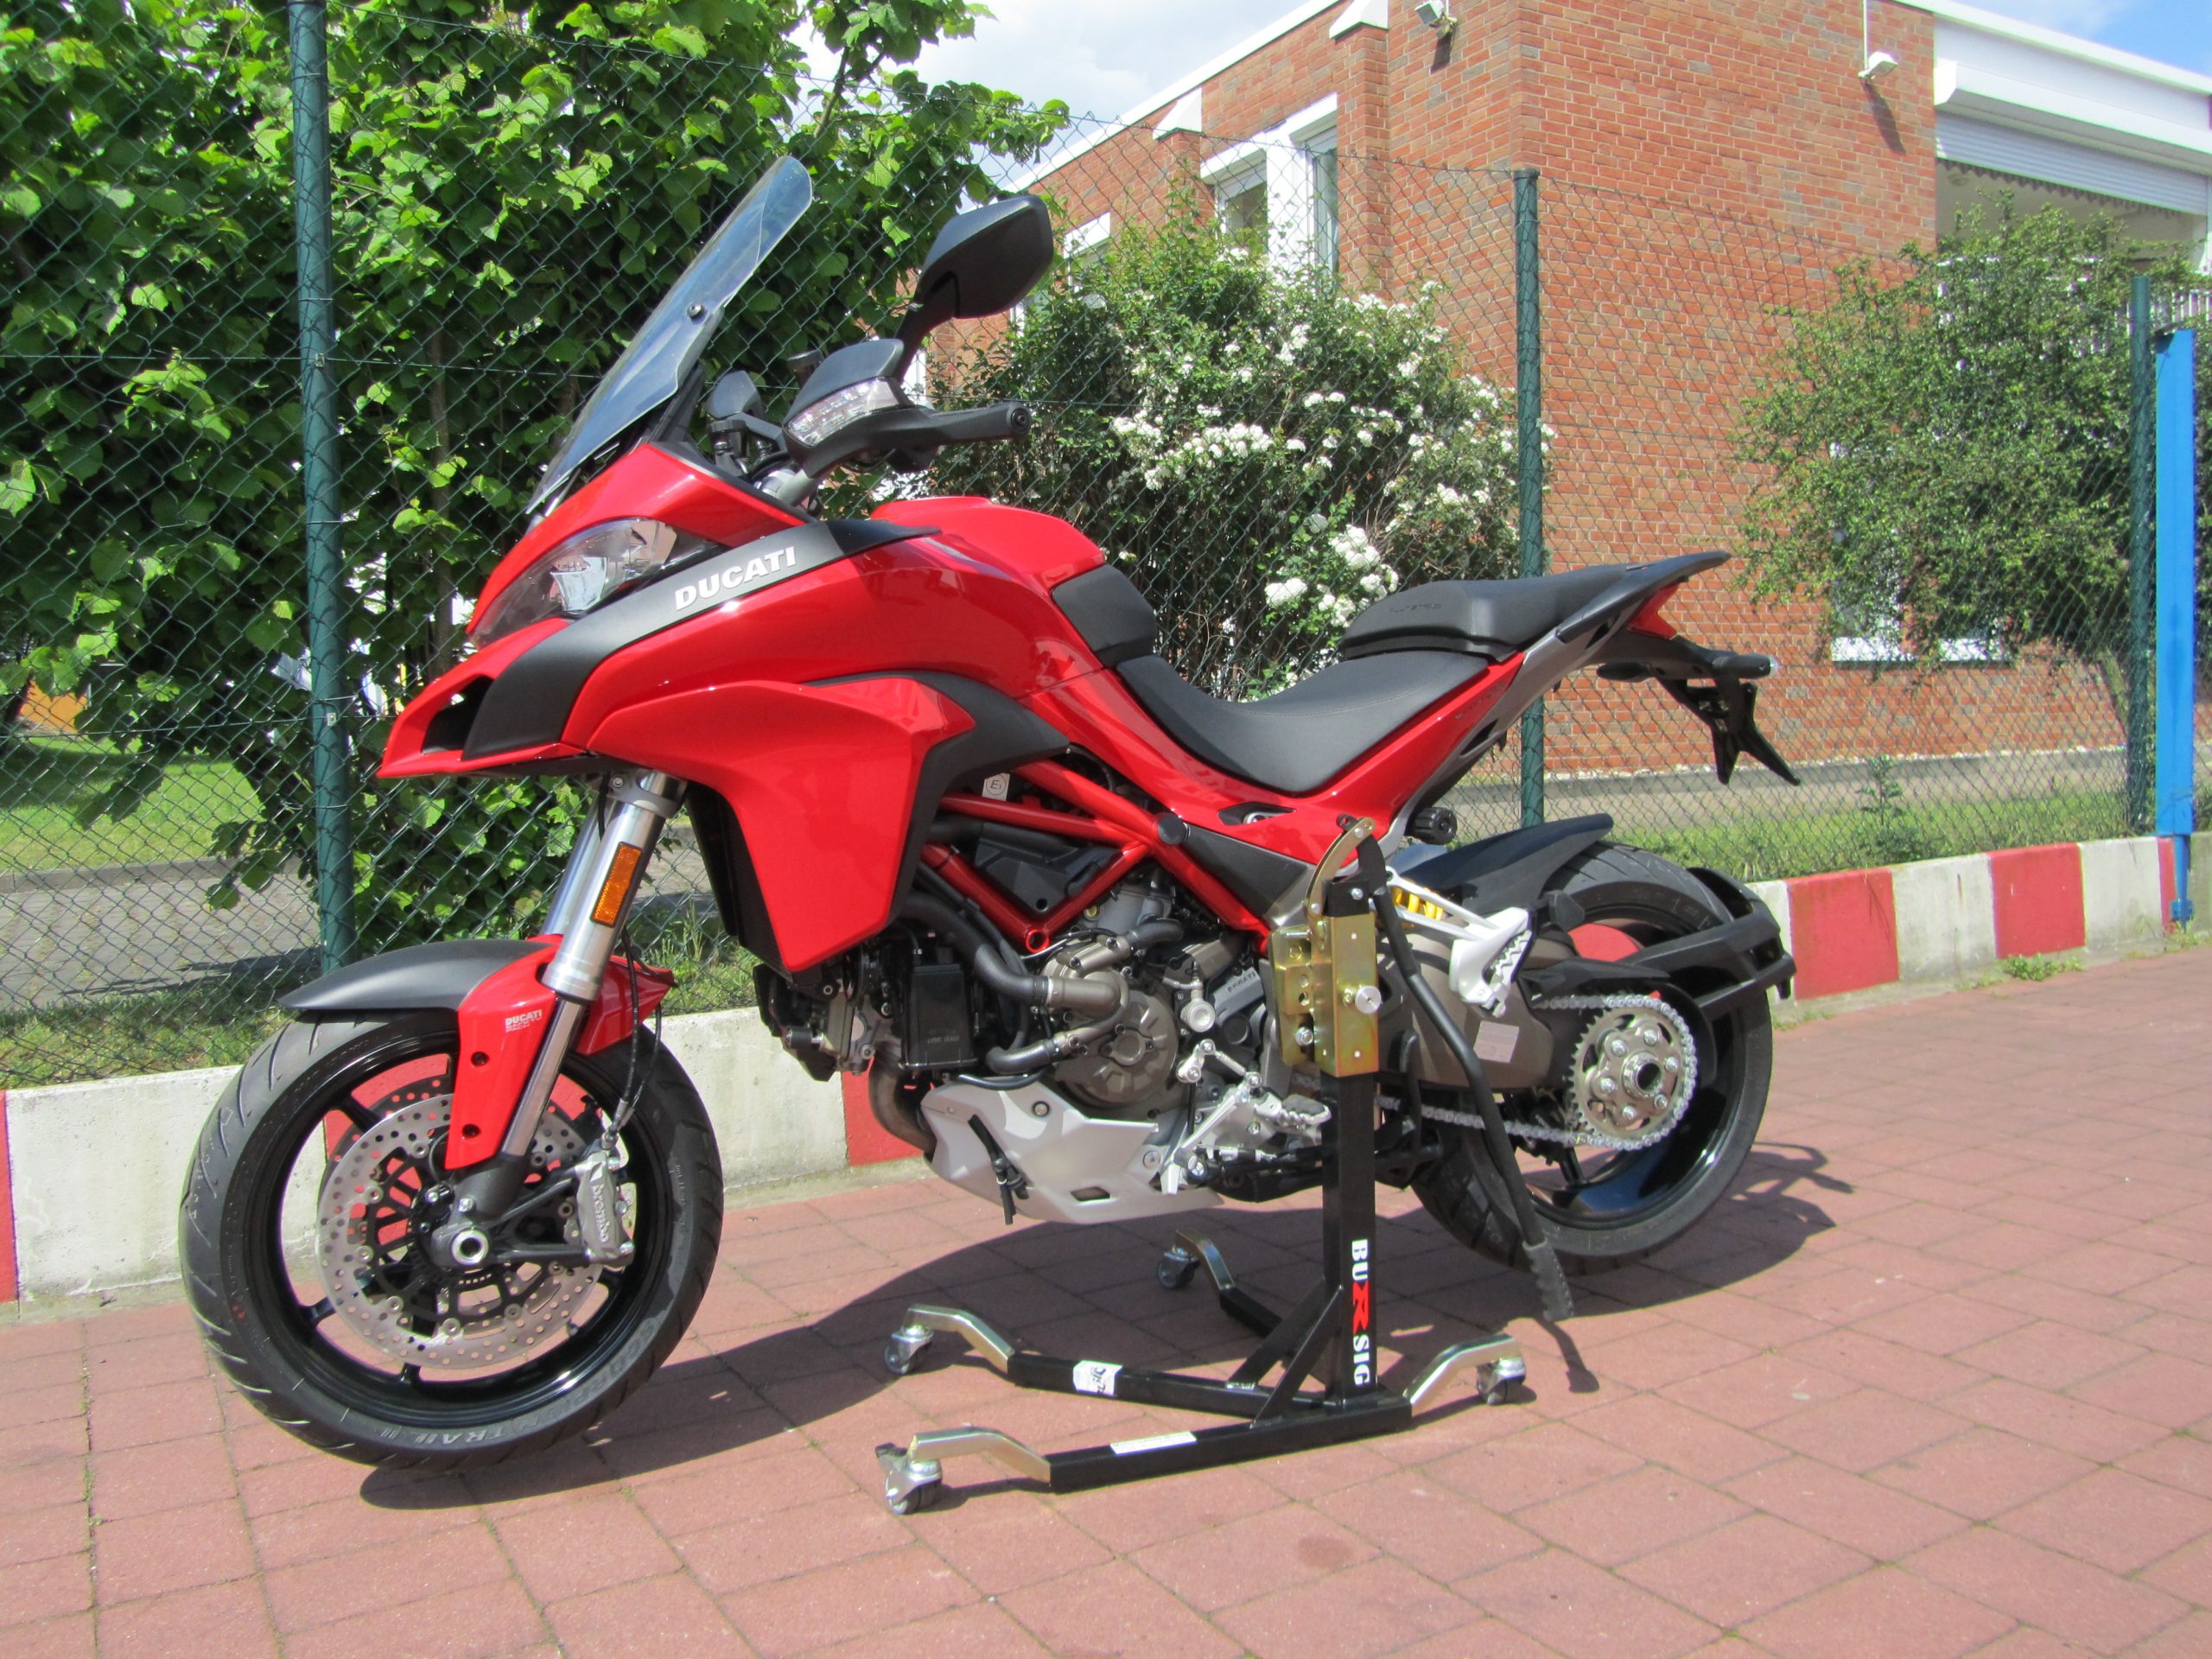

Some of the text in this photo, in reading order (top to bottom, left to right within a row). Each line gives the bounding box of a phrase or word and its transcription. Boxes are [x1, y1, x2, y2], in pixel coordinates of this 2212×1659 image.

[674, 545, 797, 611] DUCATI
[505, 1009, 543, 1026] DUCATI
[591, 1184, 609, 1243] brembo
[1351, 1238, 1370, 1386] BURSIG
[414, 1427, 505, 1445] TRAIL
